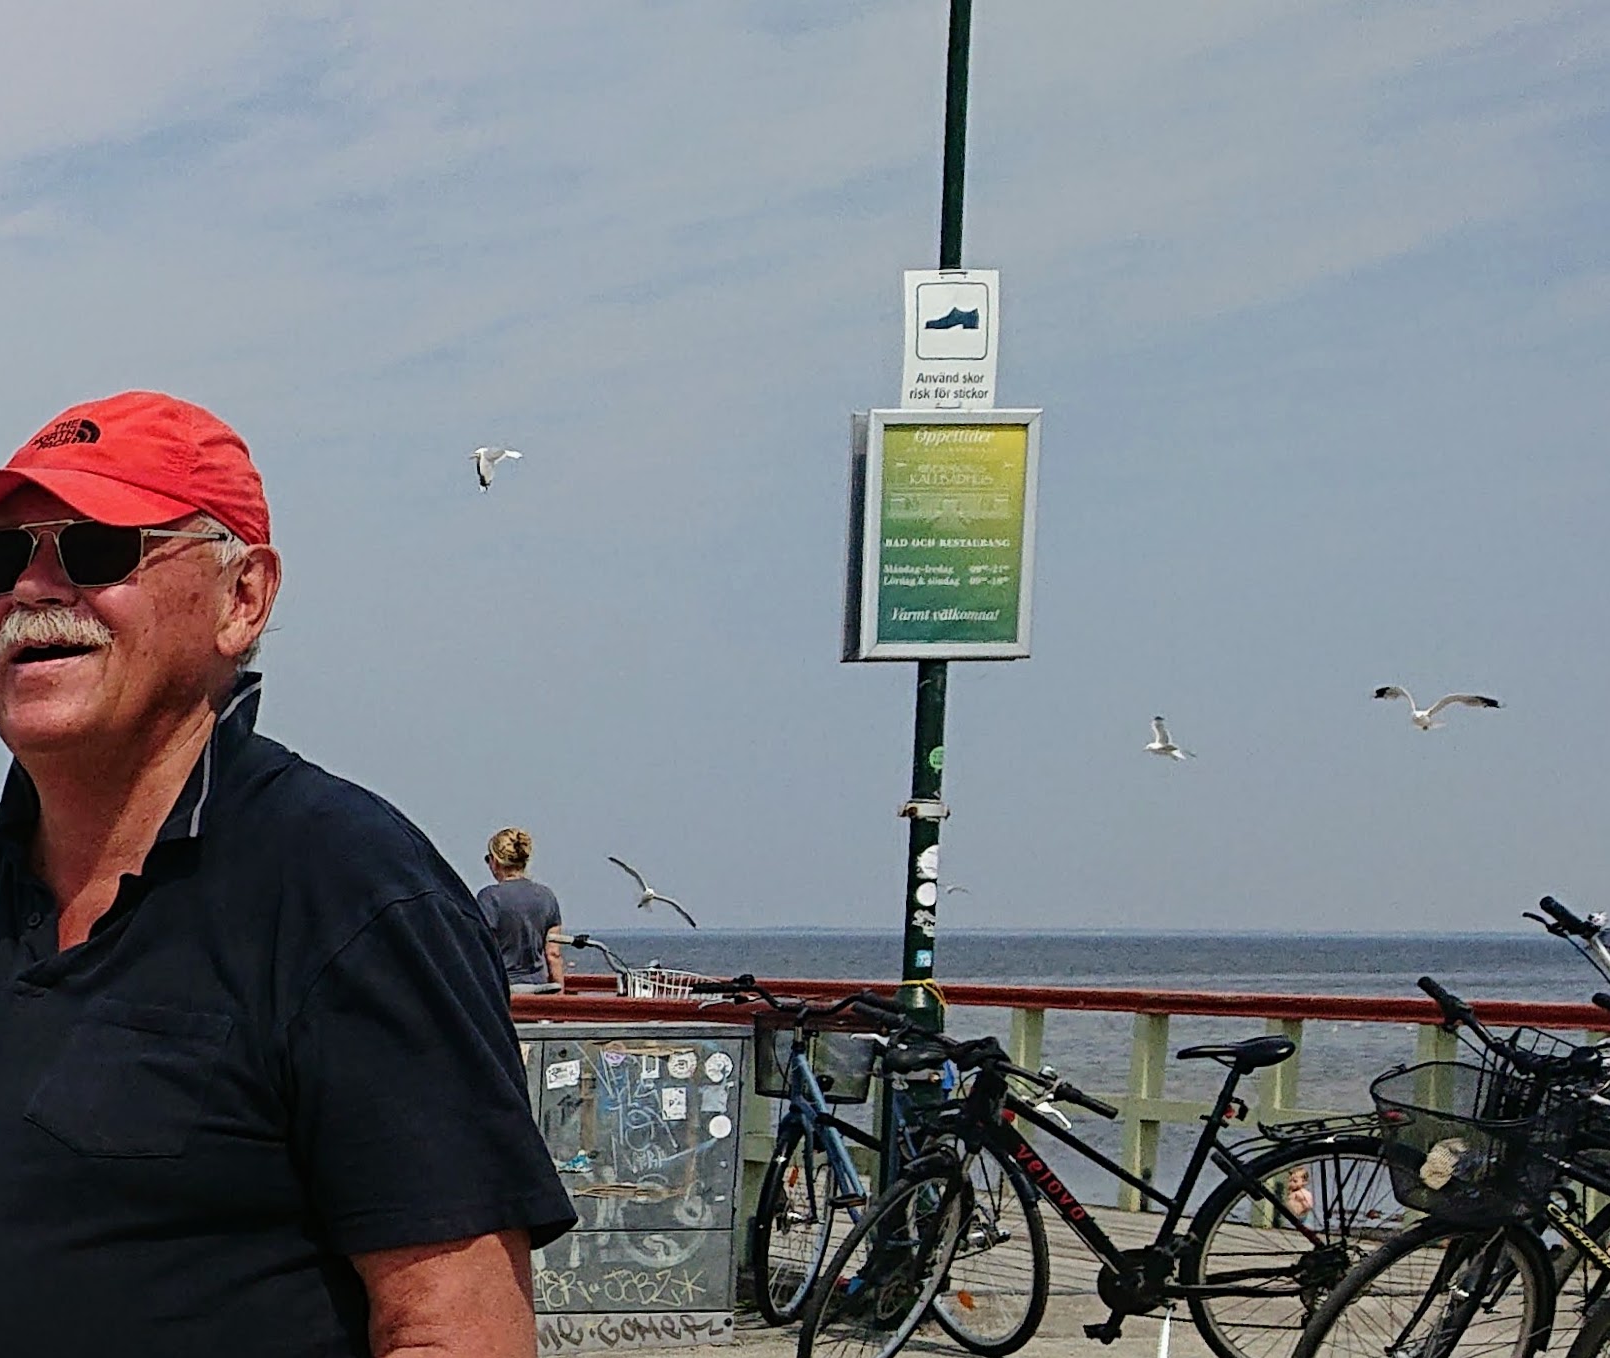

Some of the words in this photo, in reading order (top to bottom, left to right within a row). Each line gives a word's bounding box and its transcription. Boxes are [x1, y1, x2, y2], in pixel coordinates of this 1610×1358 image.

[915, 372, 959, 384] Använd
[962, 372, 985, 384] skor
[909, 387, 930, 400] risk
[934, 387, 951, 399] för
[953, 387, 989, 399] stickor
[911, 538, 935, 548] OCH
